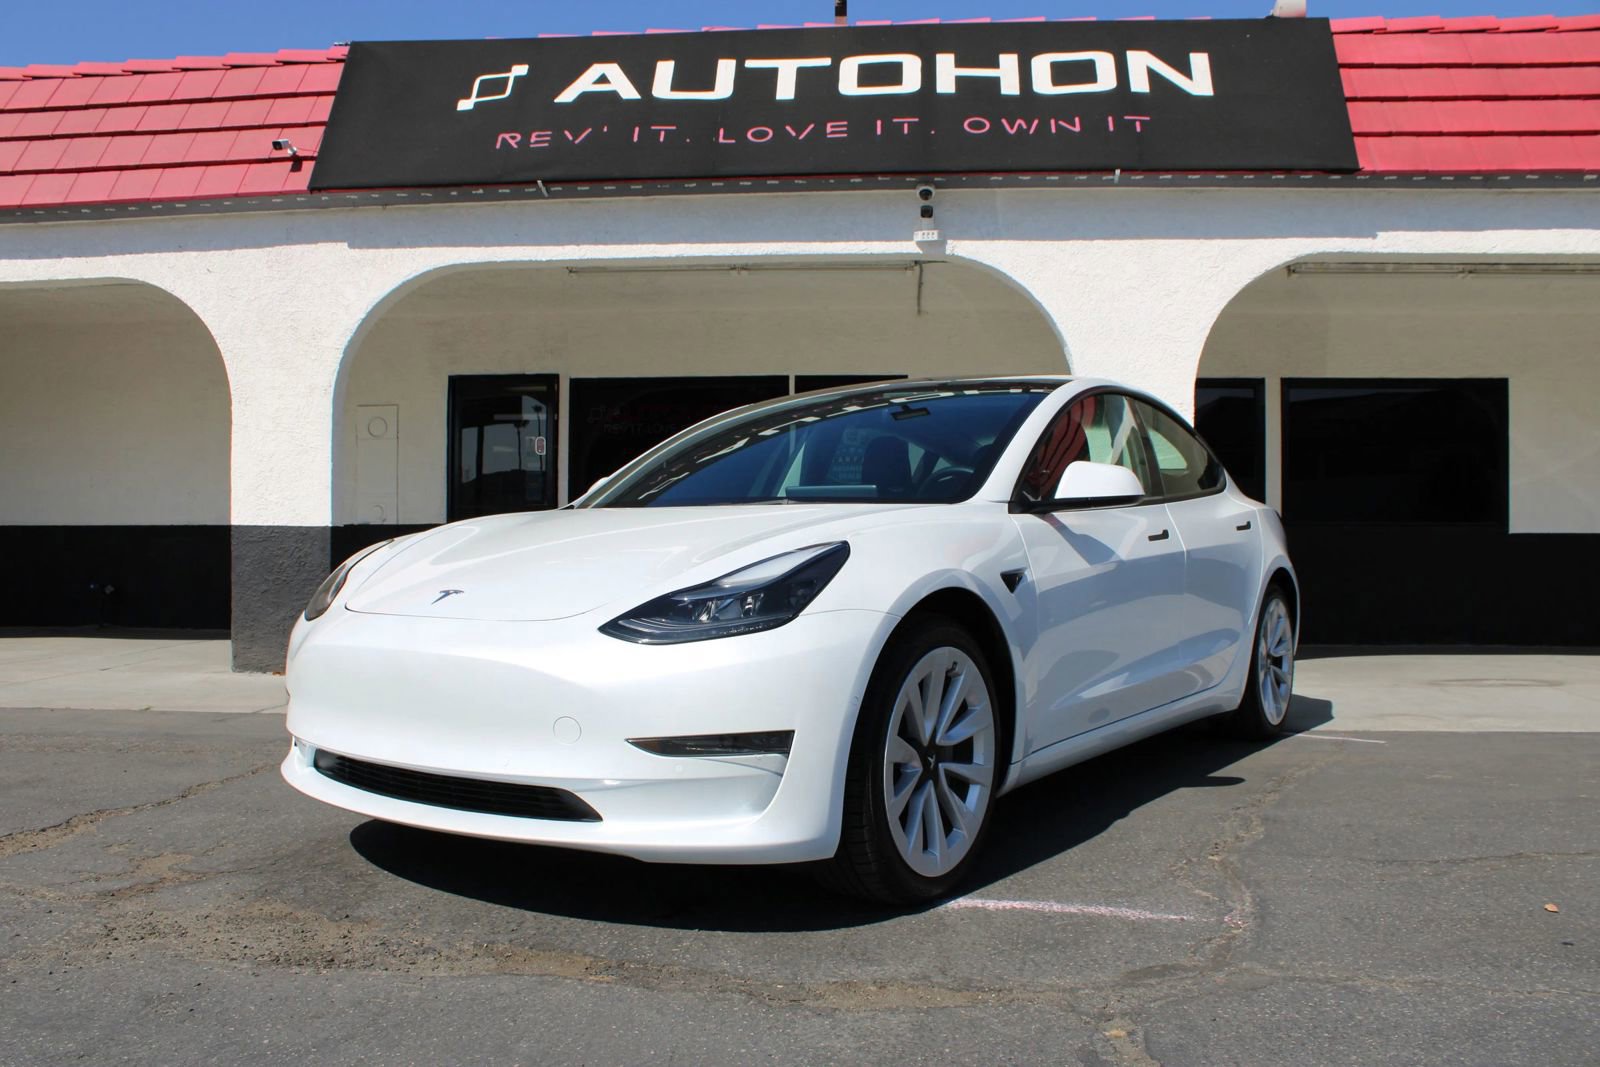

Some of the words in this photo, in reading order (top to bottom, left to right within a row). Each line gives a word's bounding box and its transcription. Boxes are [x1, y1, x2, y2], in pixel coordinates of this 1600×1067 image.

[554, 50, 1215, 105] AUTOHON
[631, 123, 690, 144] IT.
[717, 119, 849, 144] LOVE
[875, 116, 934, 135] IT.
[962, 114, 1082, 134] OWN
[1107, 113, 1152, 132] IT
